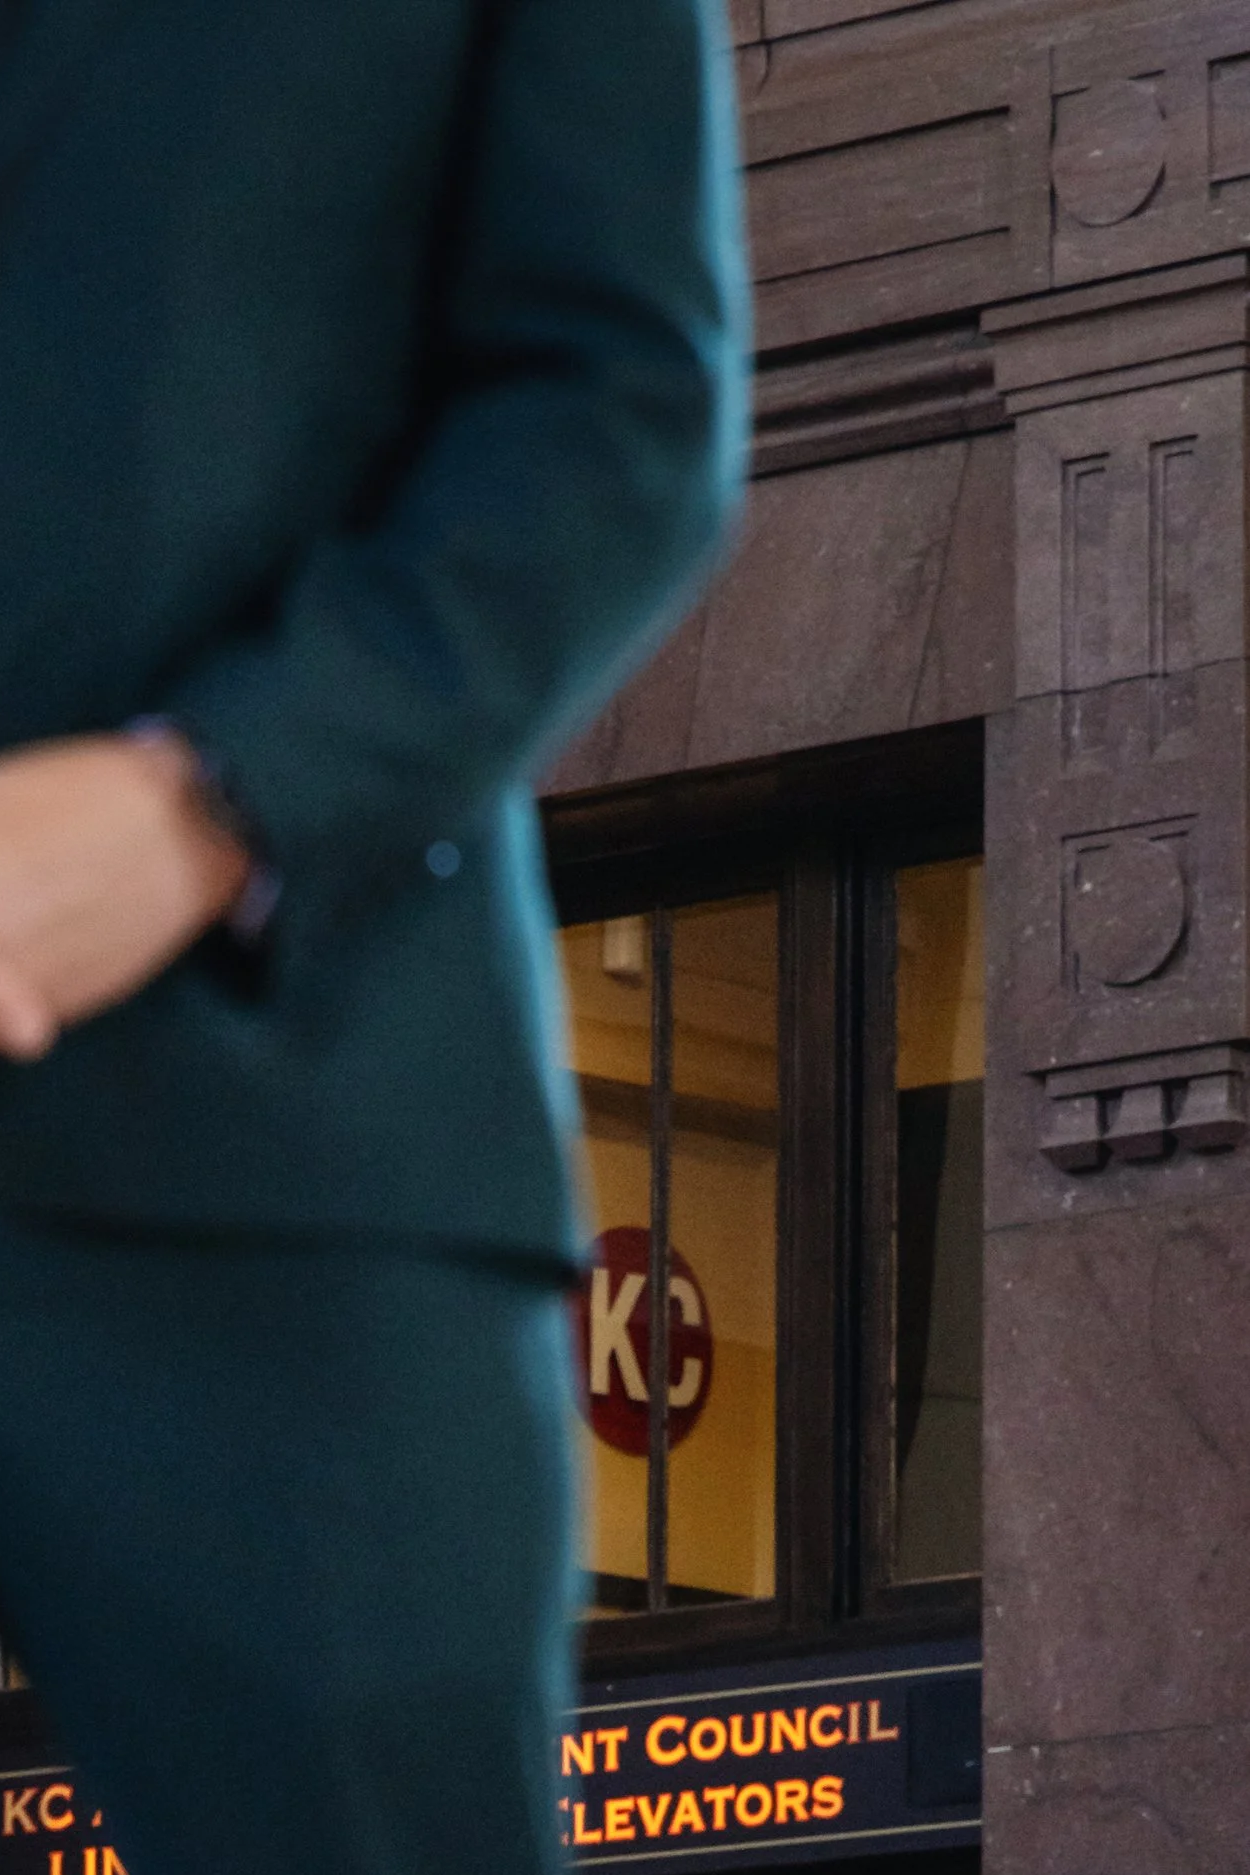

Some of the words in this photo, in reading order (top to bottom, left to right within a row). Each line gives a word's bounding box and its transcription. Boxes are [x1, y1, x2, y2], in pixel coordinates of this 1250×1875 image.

[589, 1267, 703, 1409] KC
[643, 1698, 900, 1767] COUNCIL
[1, 1782, 76, 1837] KC
[558, 1774, 846, 1847] LEVATORS
